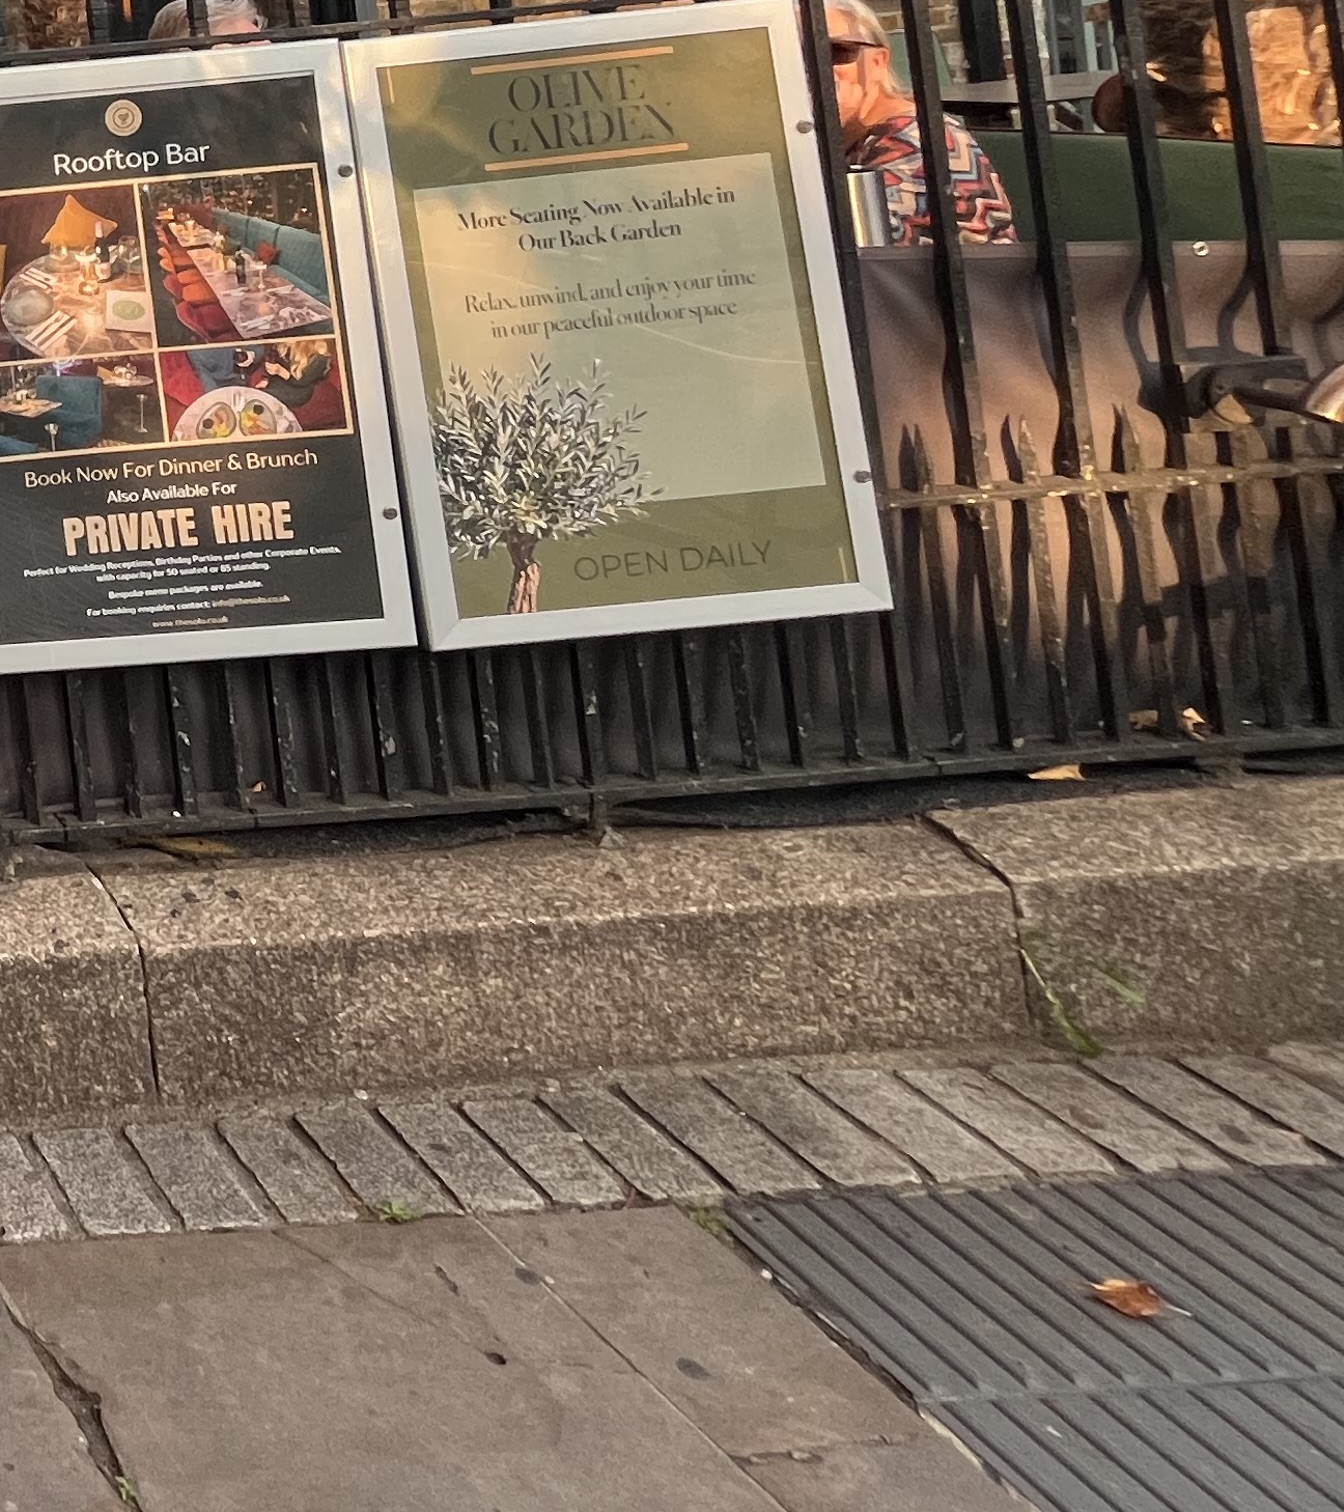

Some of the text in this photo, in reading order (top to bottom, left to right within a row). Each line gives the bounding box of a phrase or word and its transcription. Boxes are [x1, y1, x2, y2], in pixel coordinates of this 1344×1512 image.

[507, 64, 646, 112] OLIVE
[487, 102, 675, 155] GARDEN
[53, 143, 210, 176] Rooftop Bar
[457, 186, 736, 231] More Seating Now Available in
[518, 219, 682, 252] Our Back Garden
[590, 279, 623, 300] and
[625, 277, 668, 301] enjoy
[673, 276, 713, 299] your
[717, 268, 757, 288] time
[491, 300, 737, 340] in our peaceful outdoor space
[24, 449, 318, 489] Book Now For Dinner & Brunch
[107, 481, 238, 505] Also Available For
[63, 500, 294, 556] PRIVATE HIRE
[574, 540, 771, 581] OPEN DAILY
